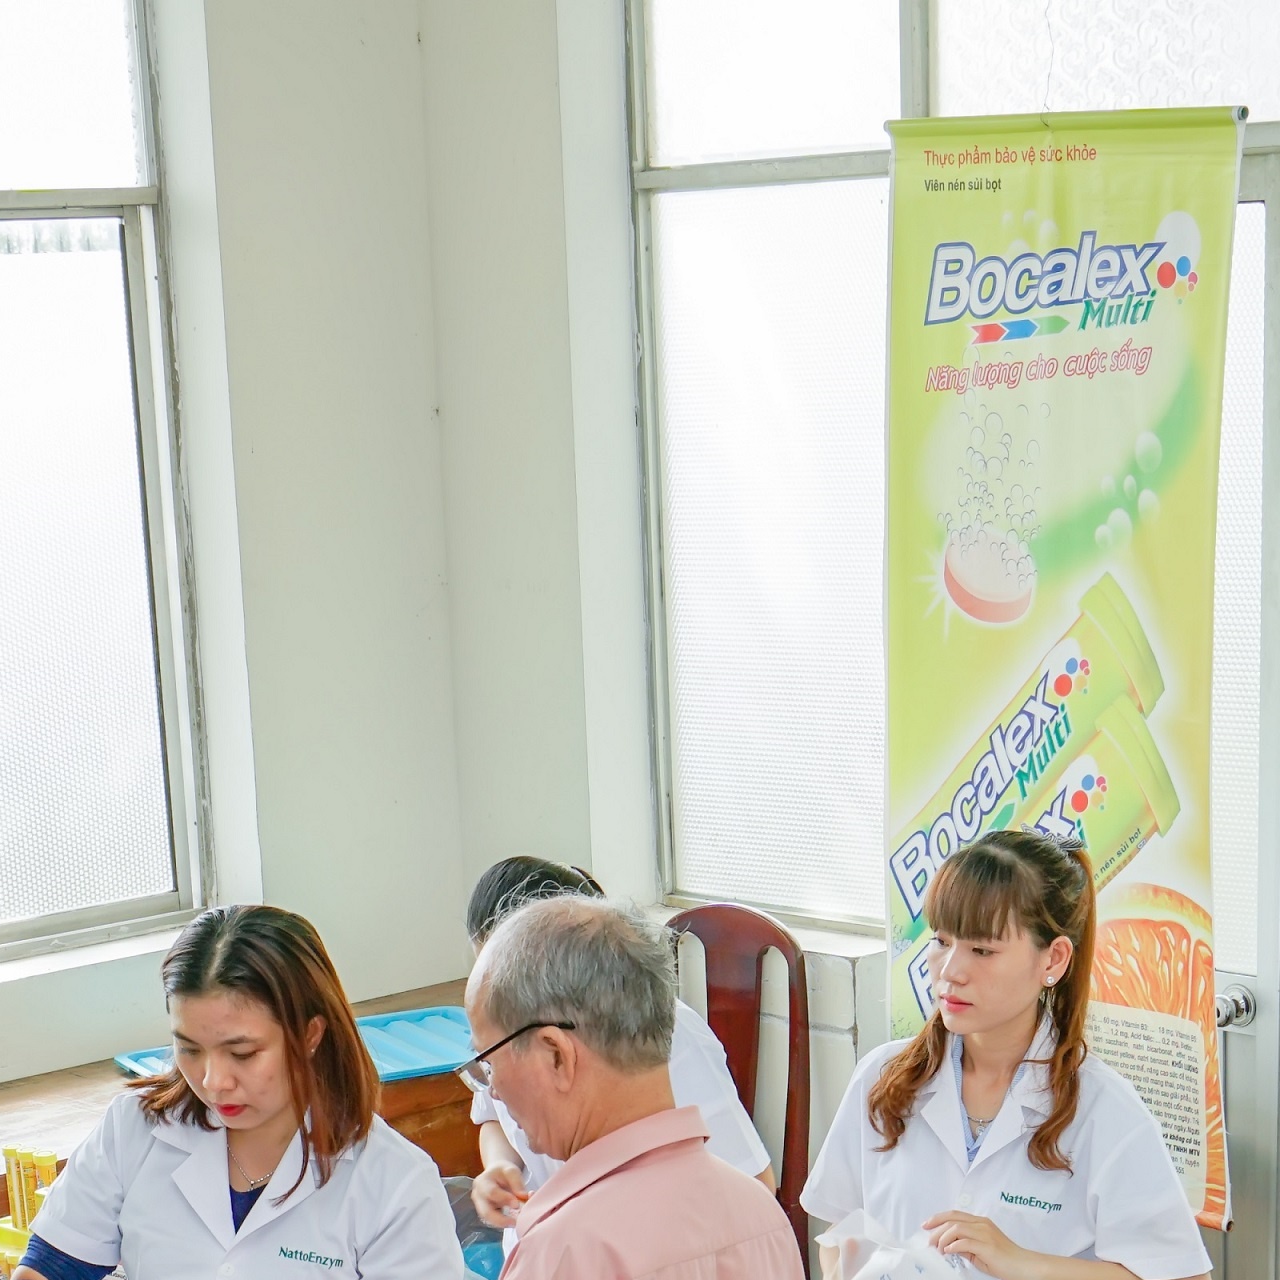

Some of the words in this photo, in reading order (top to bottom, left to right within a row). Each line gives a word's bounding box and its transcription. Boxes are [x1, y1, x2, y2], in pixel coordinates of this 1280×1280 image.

[925, 149, 954, 168] Thực
[958, 144, 991, 169] phẩm
[995, 146, 1017, 164] bảo
[1021, 148, 1036, 166] vệ
[1040, 144, 1062, 162] sức
[1066, 143, 1097, 161] khỏe
[925, 179, 945, 192] Viên
[948, 178, 966, 191] nén
[968, 178, 983, 192] sủi
[986, 178, 1001, 192] bọt
[924, 231, 1167, 326] Bocalex
[1078, 289, 1157, 332] Multi
[926, 367, 969, 394] Năng
[973, 362, 1022, 390] lượng
[1026, 355, 1058, 377] cho
[1063, 349, 1107, 375] cuộc
[1111, 338, 1152, 374] sống
[1016, 704, 1073, 802] Multi
[890, 670, 1062, 920] Bocalex
[1000, 1191, 1063, 1213] NattoEnzym
[279, 1246, 344, 1270] NattoEnzym
